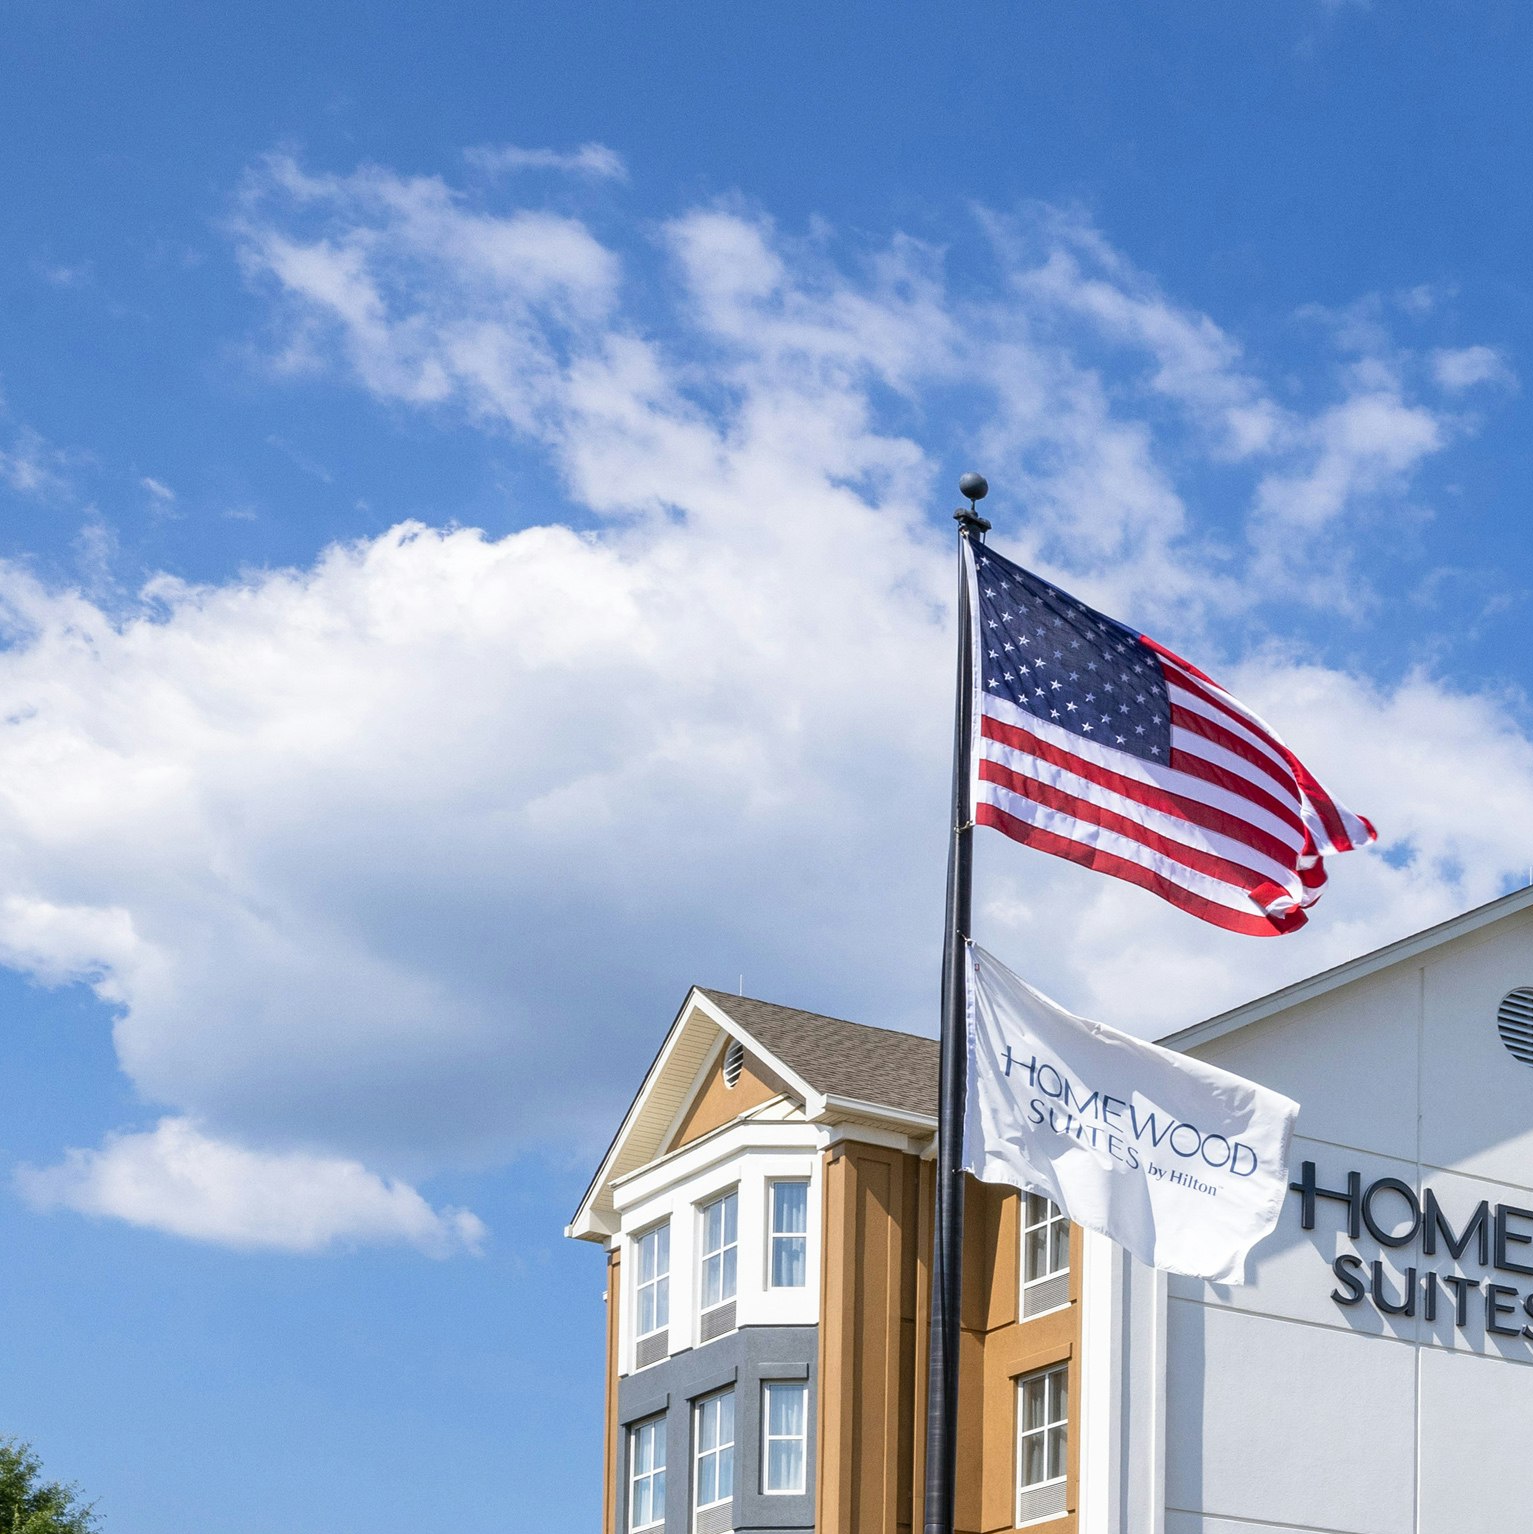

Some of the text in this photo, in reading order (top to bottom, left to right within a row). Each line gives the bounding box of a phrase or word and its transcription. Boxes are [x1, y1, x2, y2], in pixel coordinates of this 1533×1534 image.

[1001, 1046, 1258, 1177] HOMEWOOD
[1028, 1099, 1218, 1196] SUITES by Hilton
